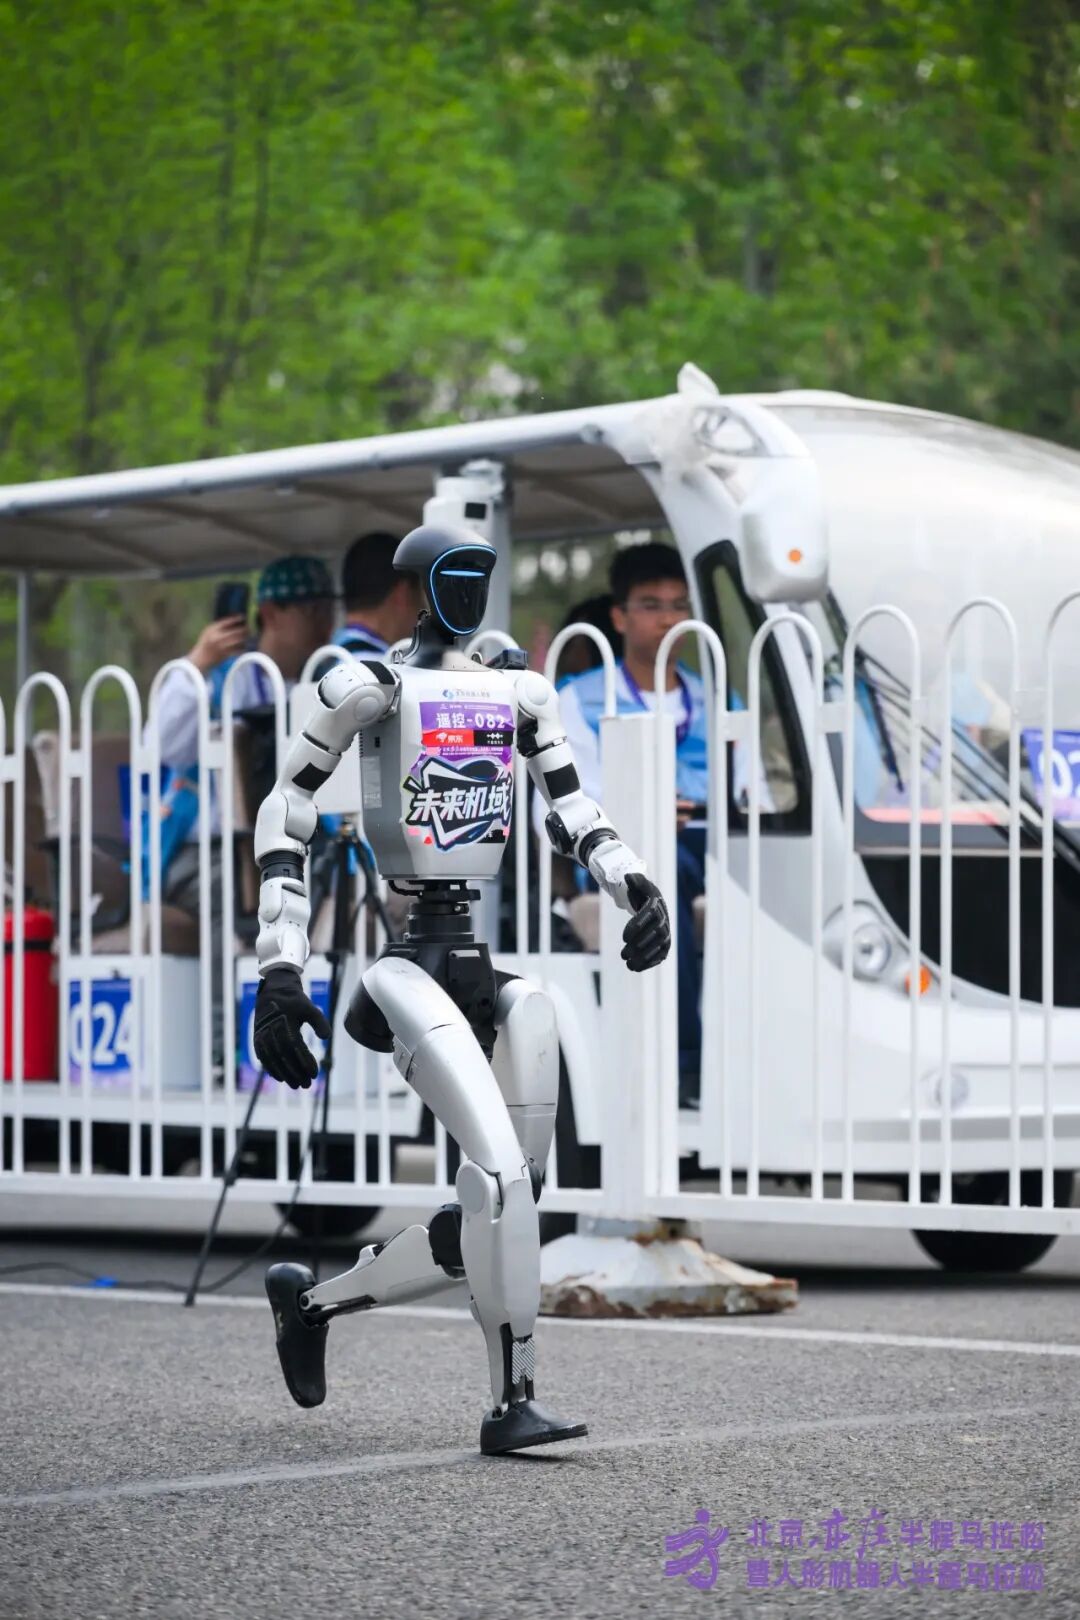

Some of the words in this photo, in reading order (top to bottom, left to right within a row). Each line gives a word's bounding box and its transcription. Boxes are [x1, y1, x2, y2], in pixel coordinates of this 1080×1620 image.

[436, 712, 506, 729] 遥控-082
[409, 779, 510, 822] 未来机域
